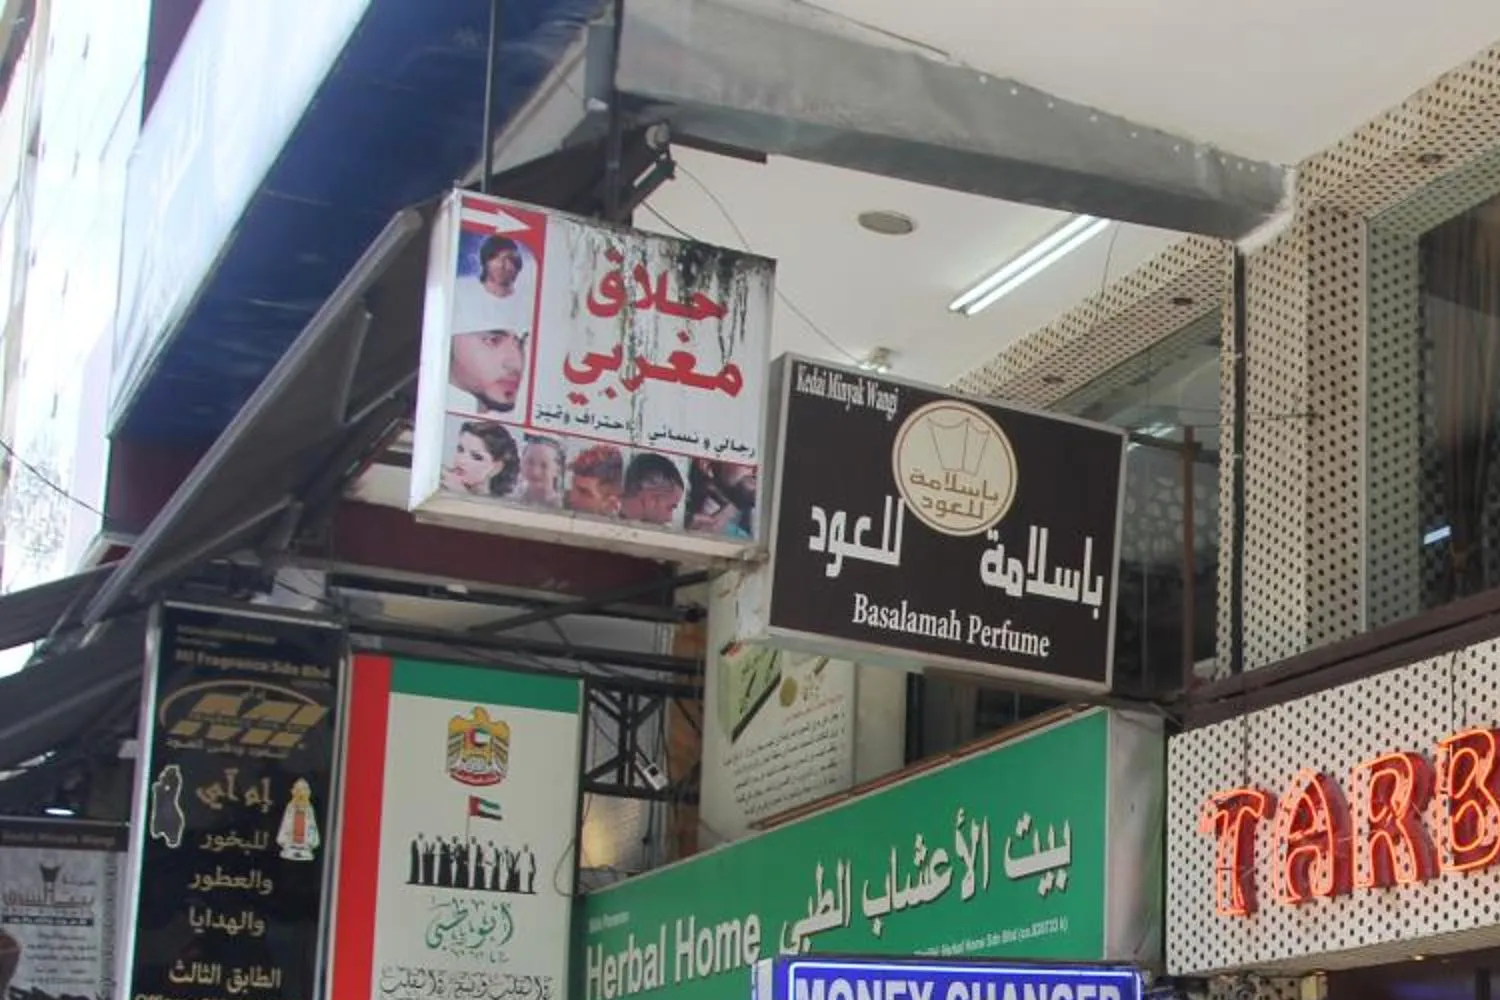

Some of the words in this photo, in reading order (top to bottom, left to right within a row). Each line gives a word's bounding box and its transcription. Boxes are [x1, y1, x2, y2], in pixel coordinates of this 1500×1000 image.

[562, 330, 743, 405] مغربي
[828, 372, 865, 412] Minyak
[867, 380, 900, 421] Wangi
[808, 495, 904, 578] للعود
[980, 525, 1104, 620] باسلامة
[852, 593, 961, 641] Basalamah
[967, 615, 1051, 657] Perfume
[862, 807, 989, 937] الأعشاب
[1003, 812, 1072, 897] بيت
[675, 914, 761, 983] Home
